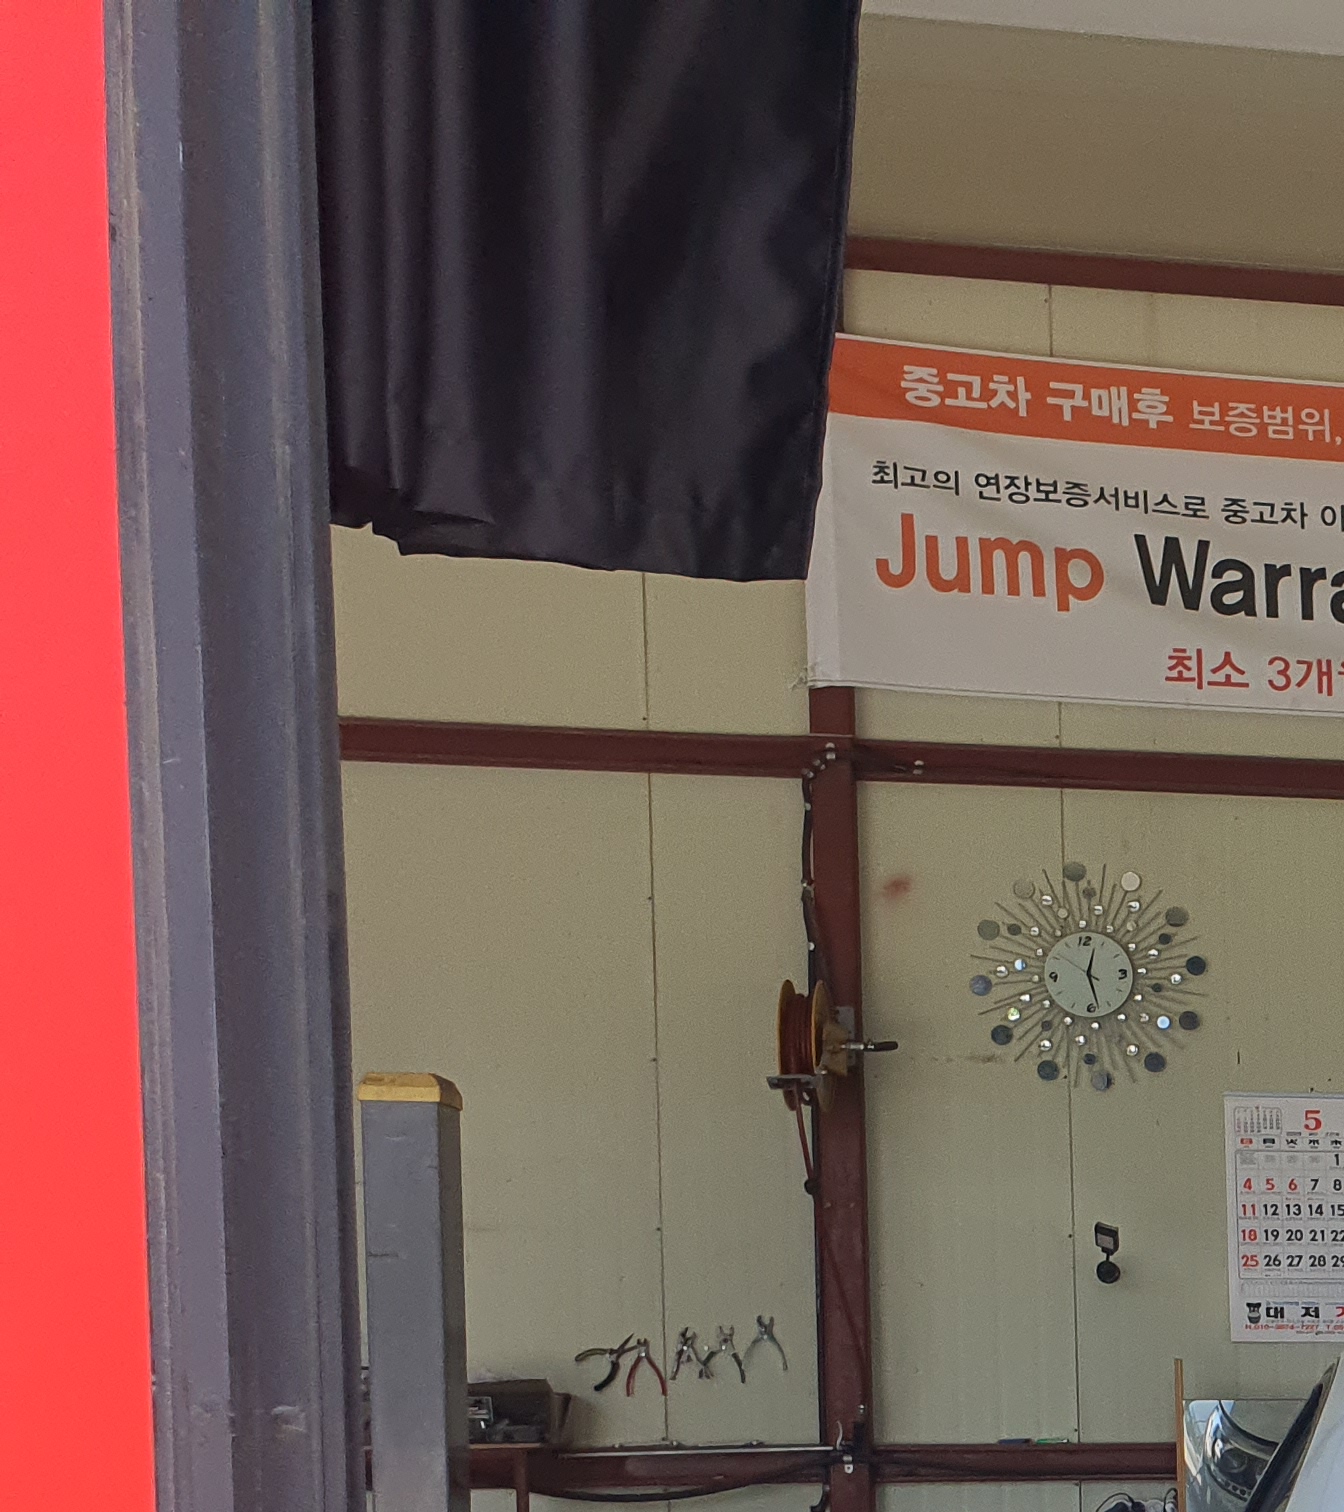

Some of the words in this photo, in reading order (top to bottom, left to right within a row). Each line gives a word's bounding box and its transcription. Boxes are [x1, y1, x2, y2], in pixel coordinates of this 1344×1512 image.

[900, 365, 1031, 417] 중고차
[1047, 382, 1174, 429] 구매후
[1189, 400, 1342, 445] 보증범위,
[871, 460, 960, 496] 최고의
[974, 473, 1210, 519] 연장보증서비스로
[1220, 498, 1308, 529] 중고차
[875, 513, 1105, 612] Jump
[1165, 647, 1249, 691] 최소
[1078, 936, 1092, 947] 12
[1049, 971, 1058, 982] 9
[1118, 969, 1127, 980] 3
[1086, 1003, 1096, 1013] 6
[1304, 1110, 1322, 1131] 5
[1335, 1154, 1339, 1166] 1
[1244, 1178, 1252, 1190] 4
[1266, 1178, 1275, 1190] 5
[1289, 1179, 1297, 1191] 6
[1311, 1179, 1319, 1190] 7
[1333, 1179, 1342, 1191] 8
[1242, 1204, 1256, 1216] 11
[1263, 1204, 1279, 1216] 12
[1285, 1204, 1301, 1216] 13
[1308, 1204, 1323, 1216] 14
[1241, 1229, 1257, 1241] 18
[1264, 1229, 1279, 1241] 19
[1286, 1229, 1303, 1241] 20
[1309, 1230, 1325, 1241] 21
[1241, 1255, 1259, 1267] 25
[1264, 1255, 1281, 1267] 26
[1286, 1255, 1303, 1267] 27
[1309, 1255, 1326, 1267] 28
